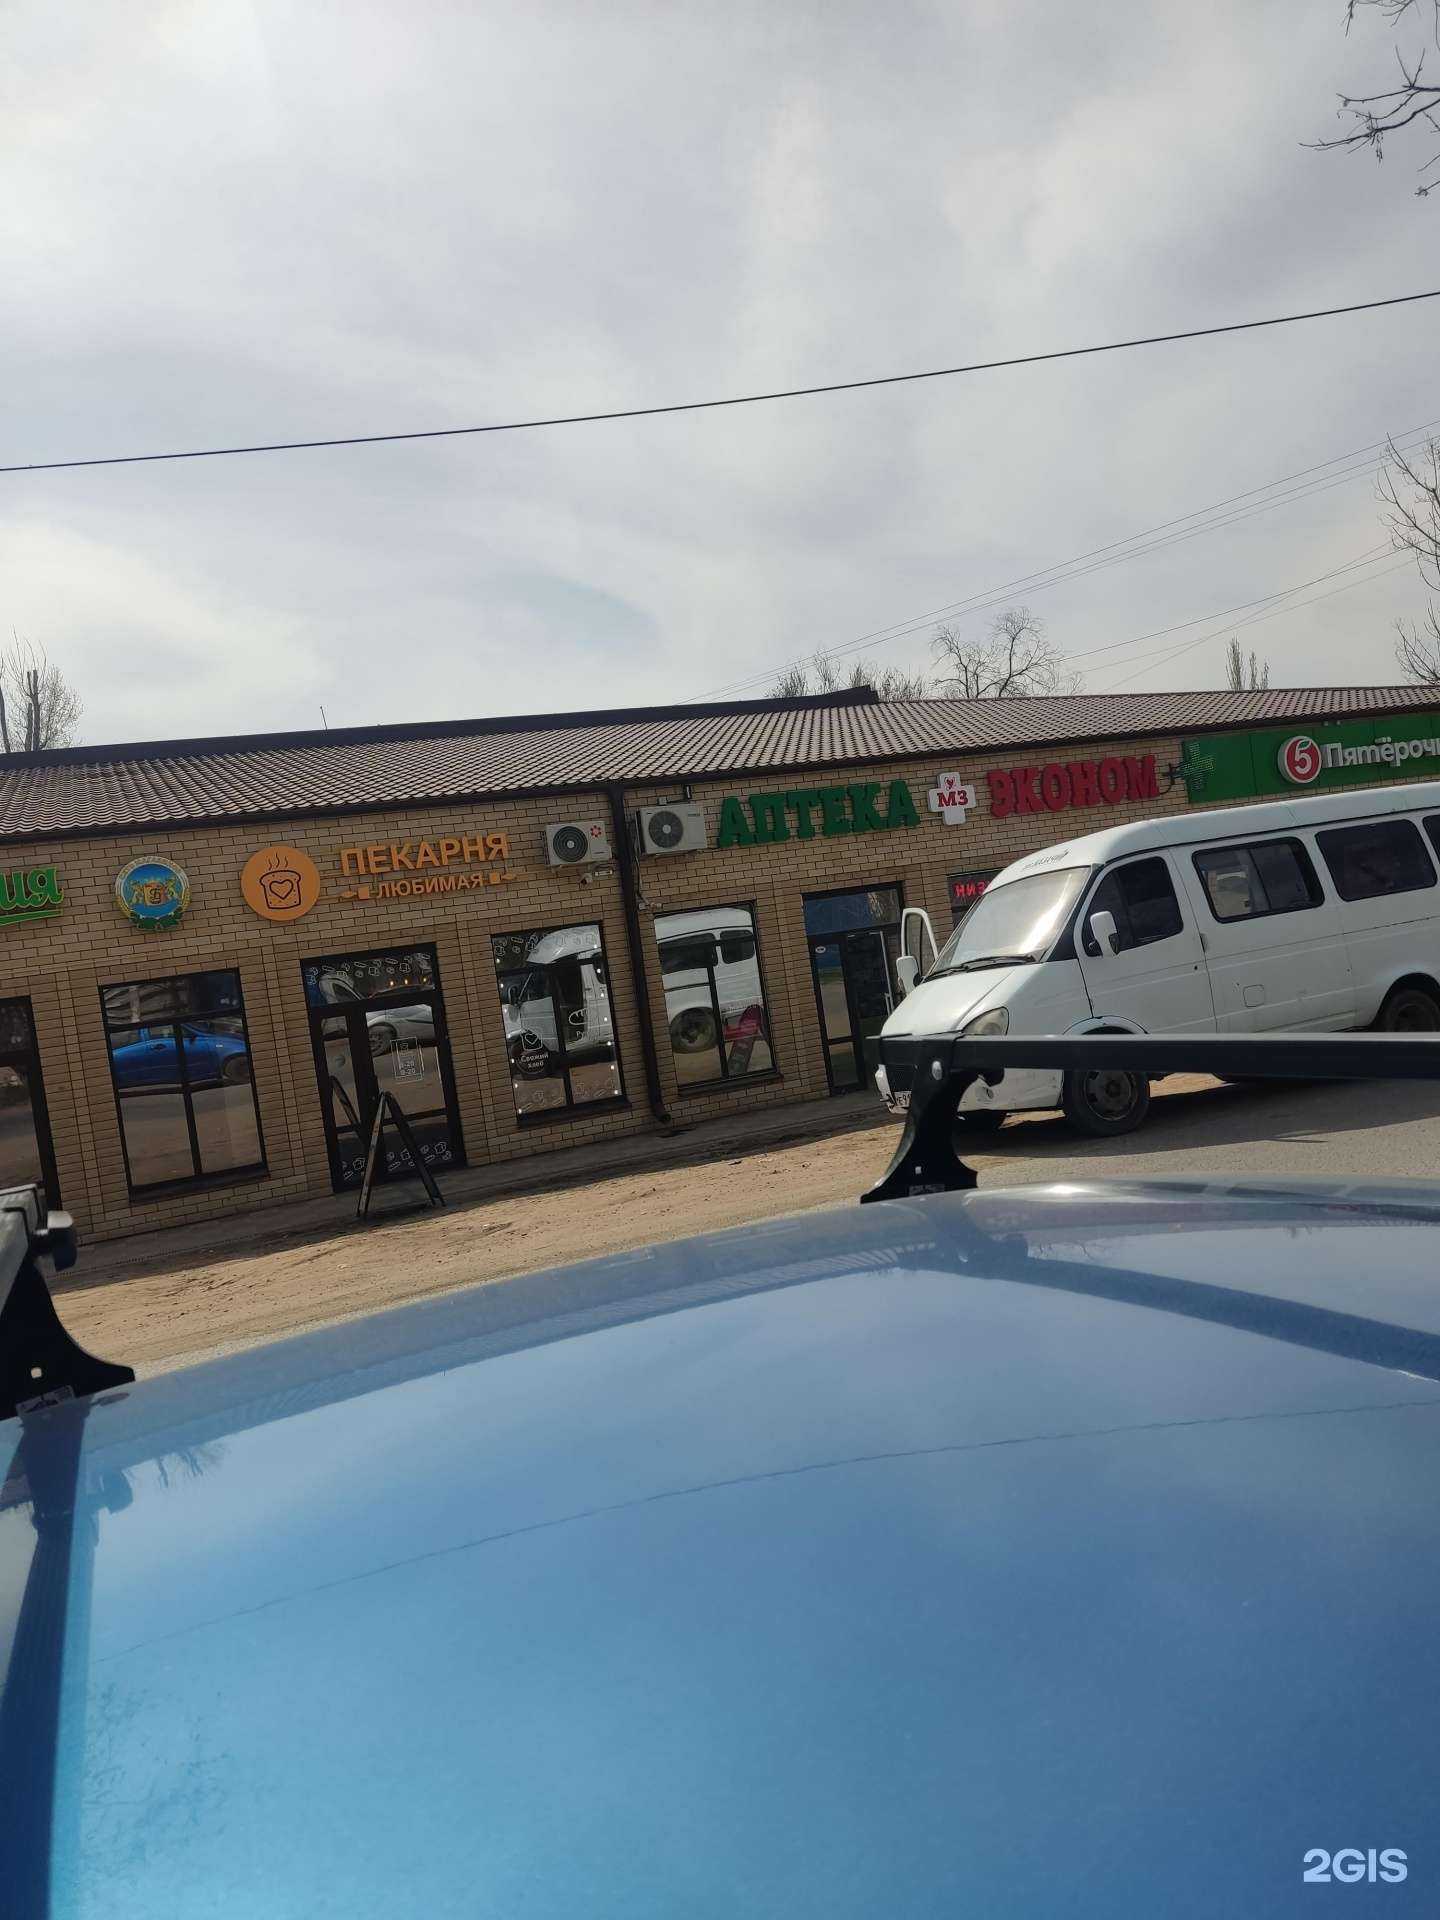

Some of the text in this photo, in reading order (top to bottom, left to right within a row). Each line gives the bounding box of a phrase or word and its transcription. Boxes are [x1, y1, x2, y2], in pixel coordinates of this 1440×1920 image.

[717, 779, 921, 848] АПТЕКА
[987, 755, 1160, 819] ЭКОНОМ
[340, 832, 510, 876] ПЕКАРНЯ
[376, 871, 484, 899] ЛЮБИМАЯ
